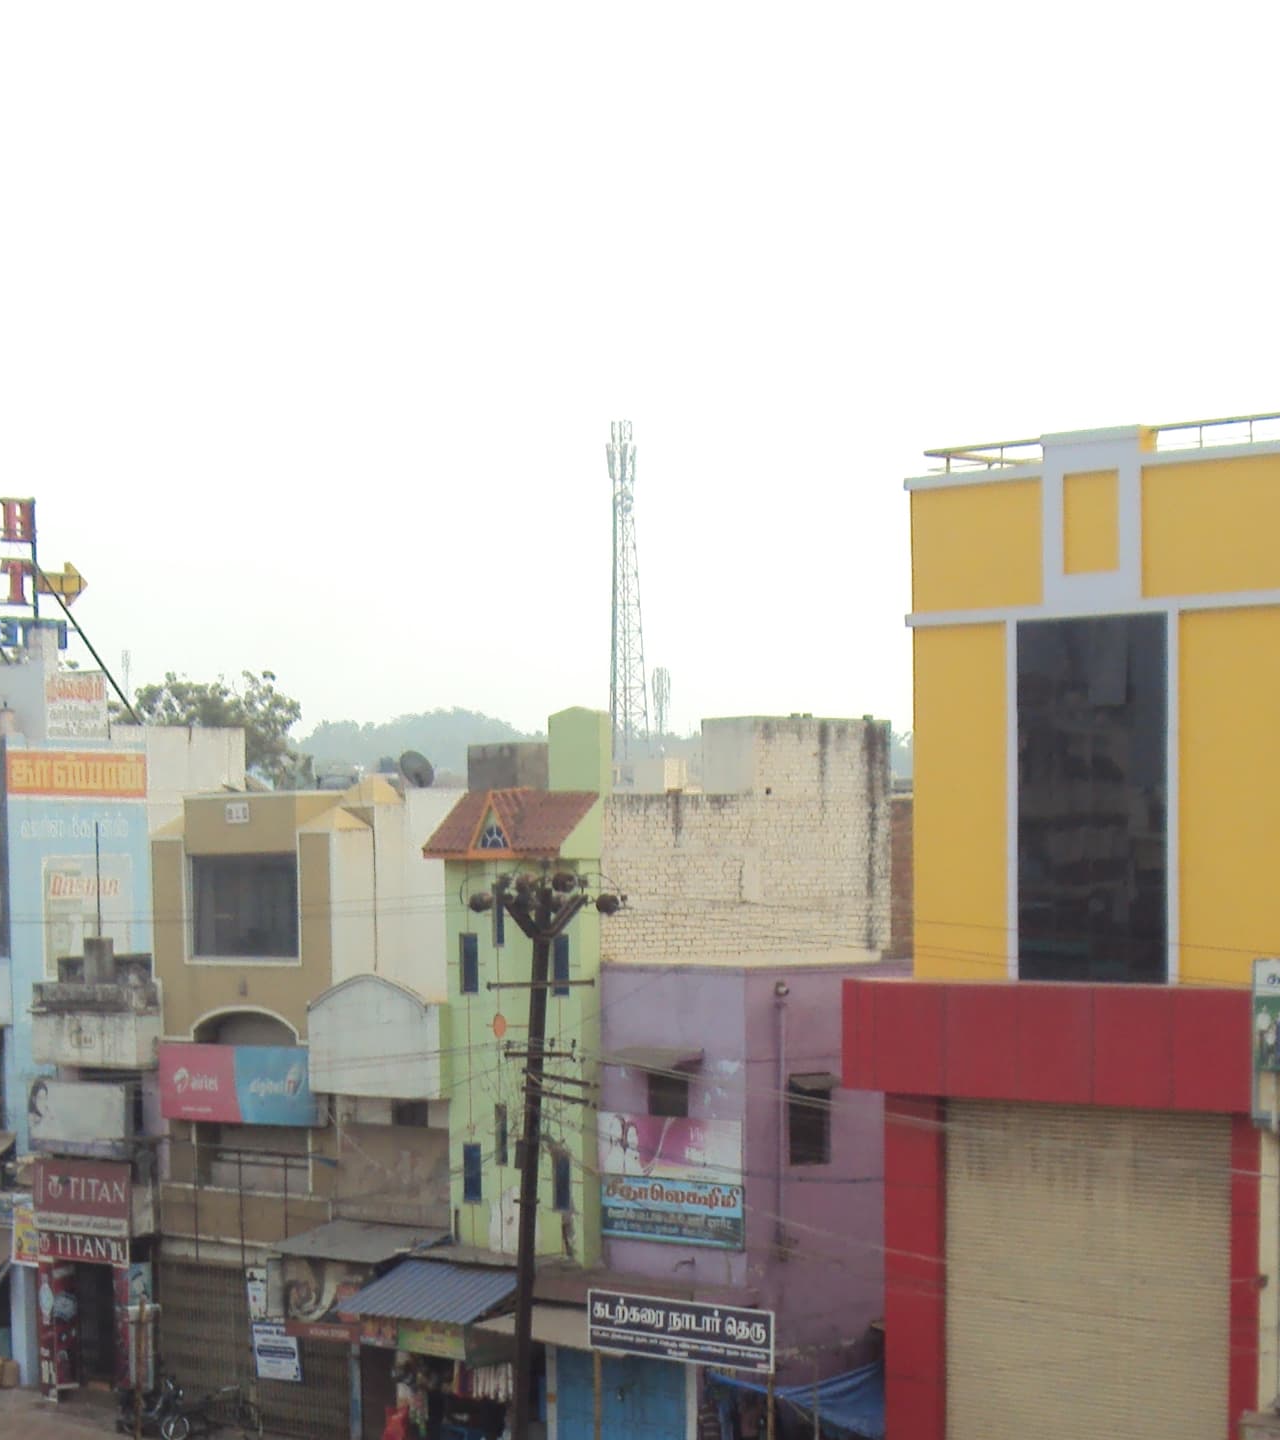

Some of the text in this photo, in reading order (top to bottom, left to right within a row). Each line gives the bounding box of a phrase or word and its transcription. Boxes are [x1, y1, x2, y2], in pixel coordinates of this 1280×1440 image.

[191, 1073, 219, 1092] airtel
[69, 1176, 127, 1203] TITAN
[54, 1231, 114, 1259] TITAN
[592, 1297, 666, 1329] கடற்கரை
[667, 1308, 722, 1333] நாடார்
[724, 1316, 767, 1345] தெரு
